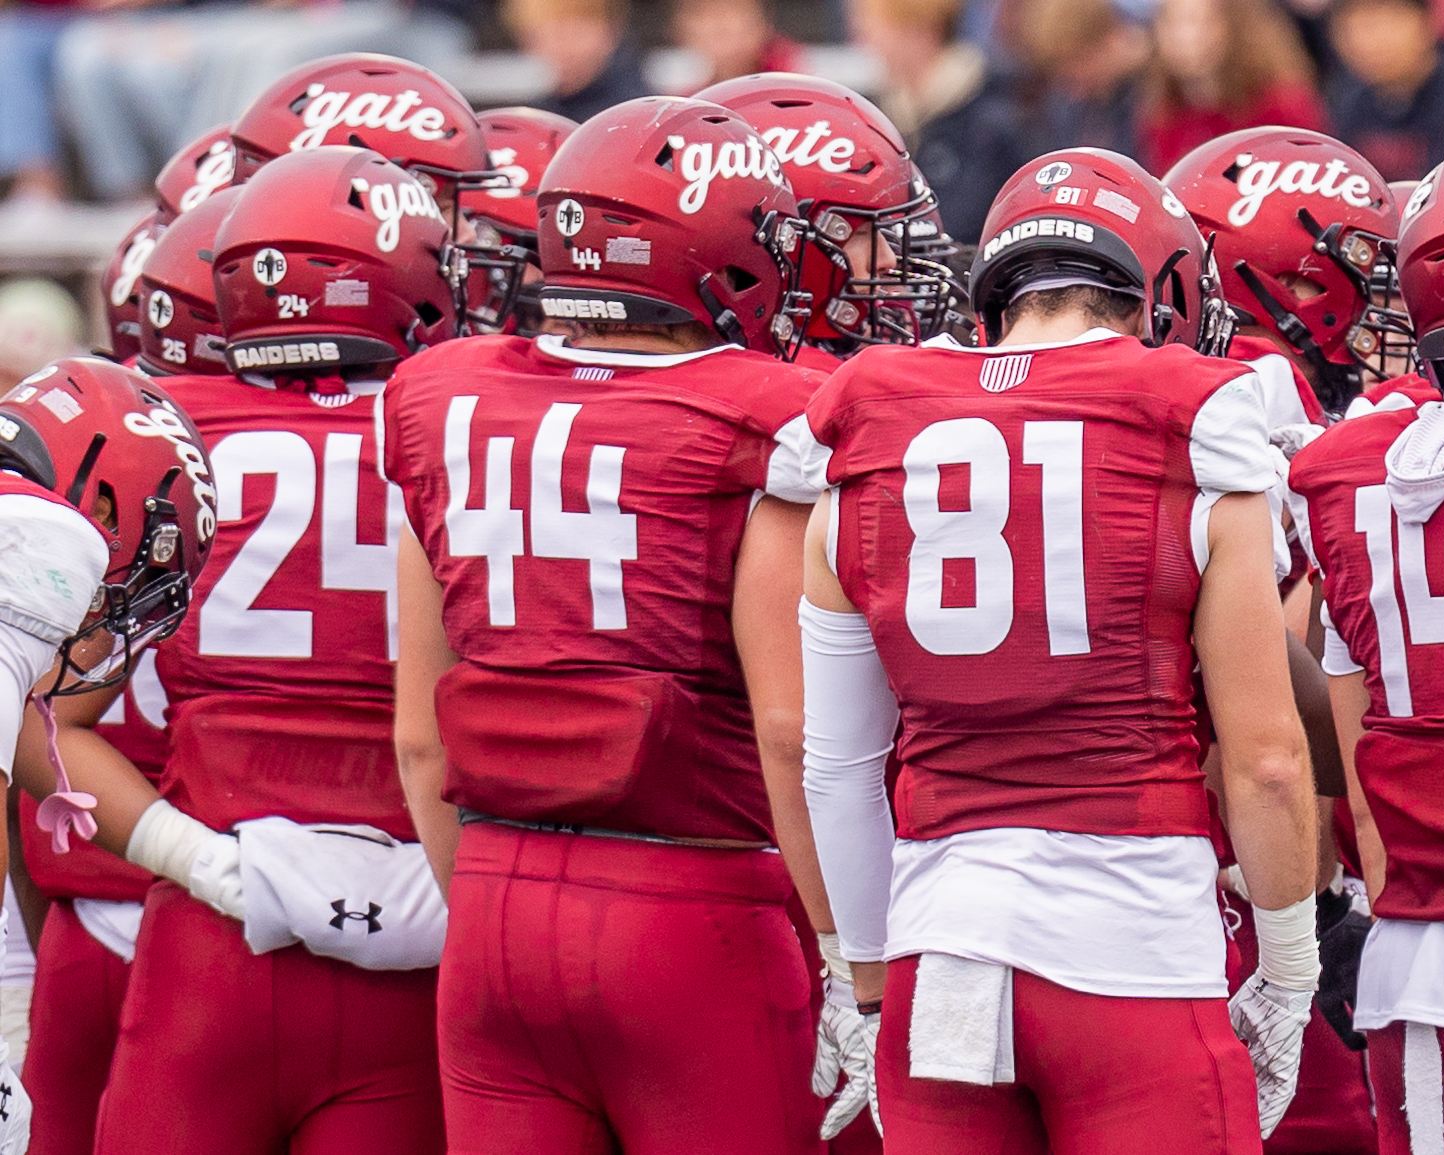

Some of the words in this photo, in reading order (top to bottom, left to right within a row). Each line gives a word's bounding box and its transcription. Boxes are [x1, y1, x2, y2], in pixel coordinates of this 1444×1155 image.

[1055, 186, 1081, 205] 81
[984, 219, 1094, 261] RAIDERS
[572, 247, 601, 270] 44
[278, 294, 309, 319] 24
[162, 337, 187, 364] 25
[233, 342, 341, 369] RAIDERS
[444, 395, 638, 630] 44
[199, 431, 399, 661] 24
[903, 417, 1092, 657] 81
